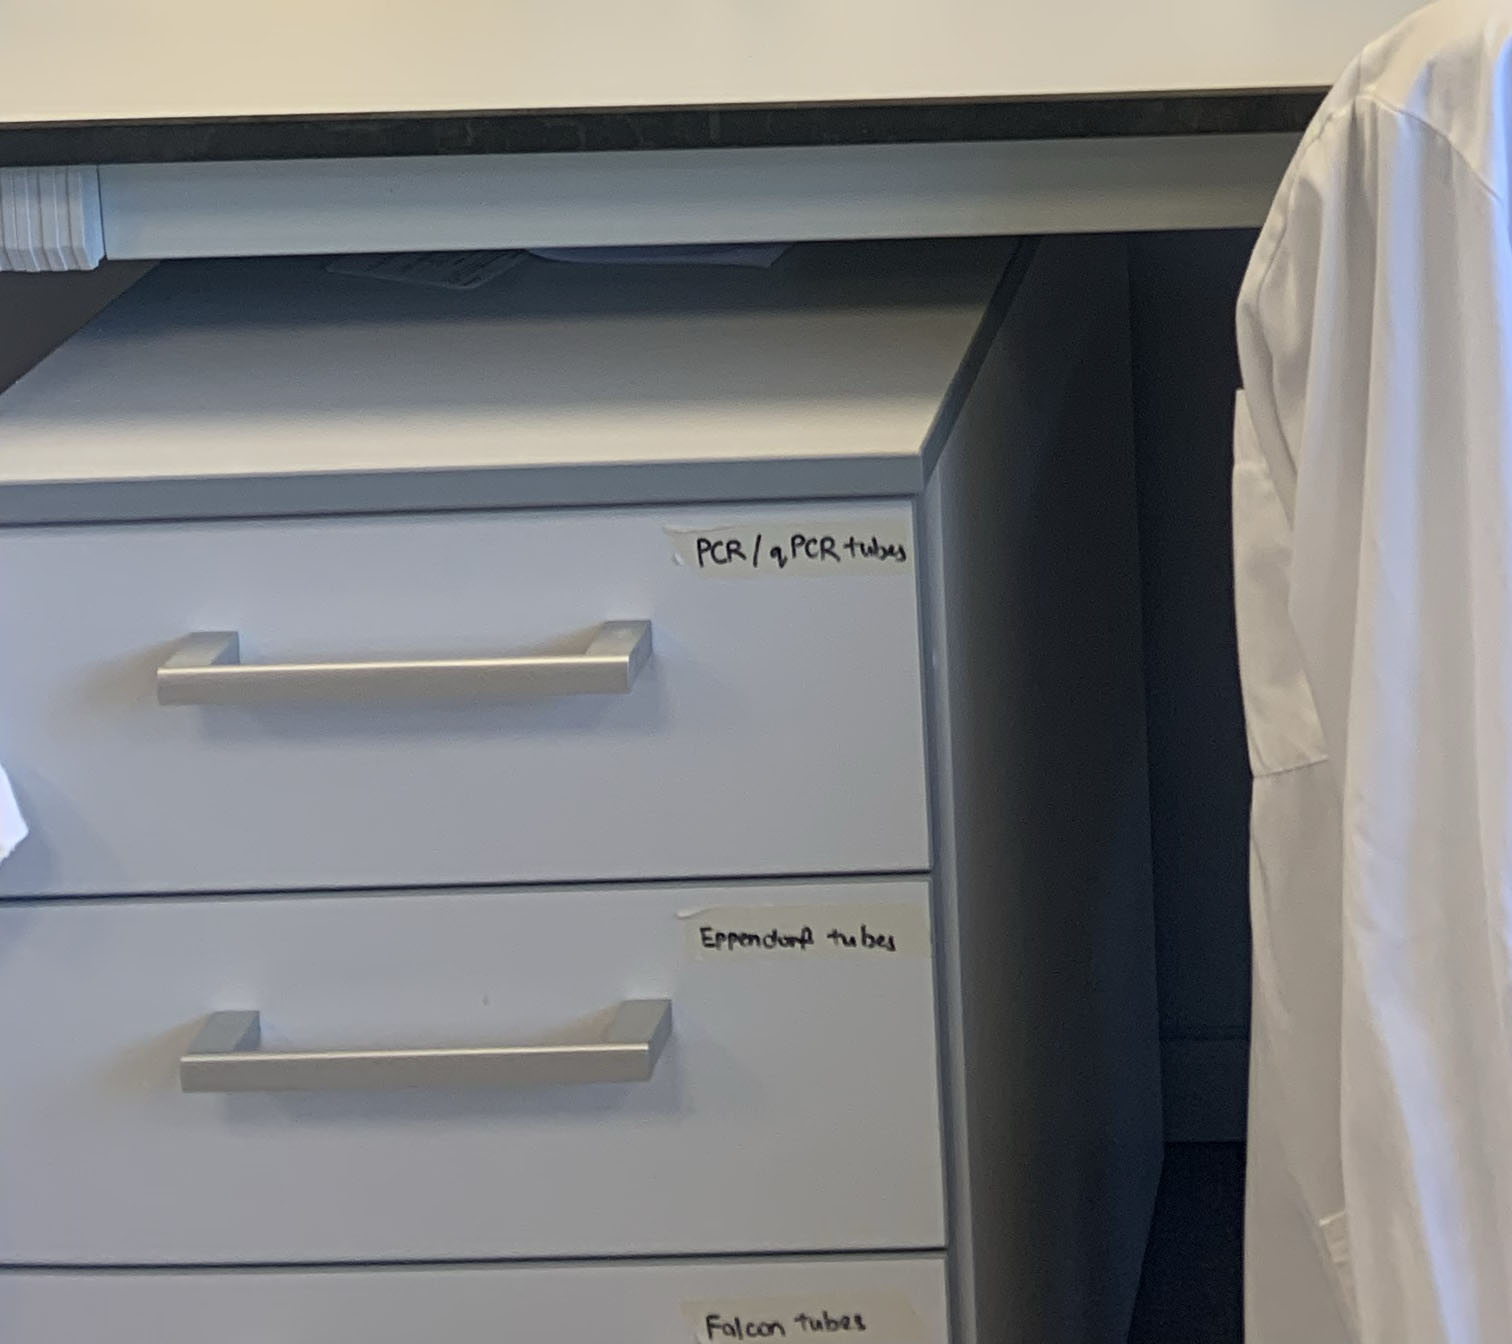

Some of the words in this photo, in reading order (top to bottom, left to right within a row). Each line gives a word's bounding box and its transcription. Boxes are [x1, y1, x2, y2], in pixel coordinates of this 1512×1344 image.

[696, 537, 747, 568] PCR
[843, 536, 907, 563] tubes
[699, 926, 815, 952] Eppendorf
[826, 924, 897, 952] tubes
[704, 1314, 787, 1341] Falcon
[793, 1310, 867, 1332] tubes
